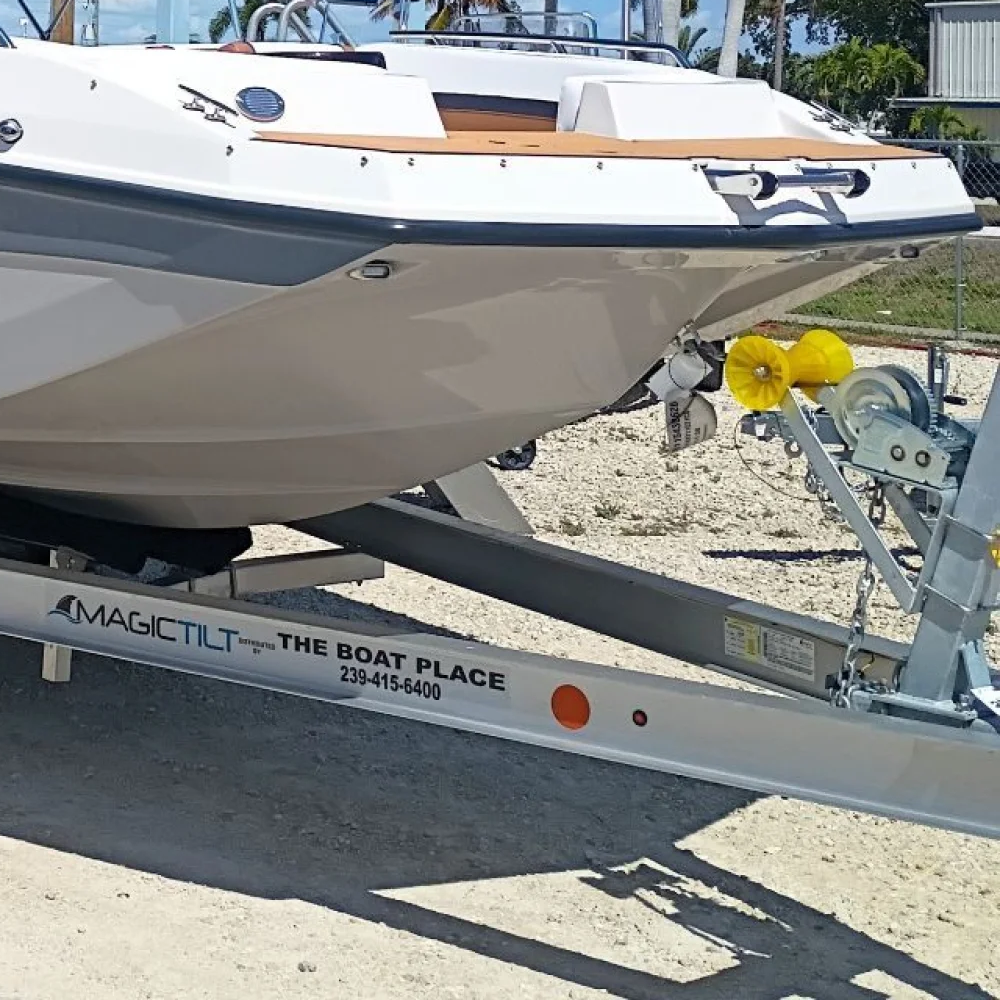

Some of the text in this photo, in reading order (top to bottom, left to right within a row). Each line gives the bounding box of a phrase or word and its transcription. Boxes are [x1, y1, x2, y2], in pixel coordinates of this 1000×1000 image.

[76, 599, 239, 653] MAGICTILT
[277, 632, 328, 656] THE
[337, 642, 407, 670] BOAT
[416, 657, 506, 692] PLACE
[340, 665, 441, 701] 239-415-6400
